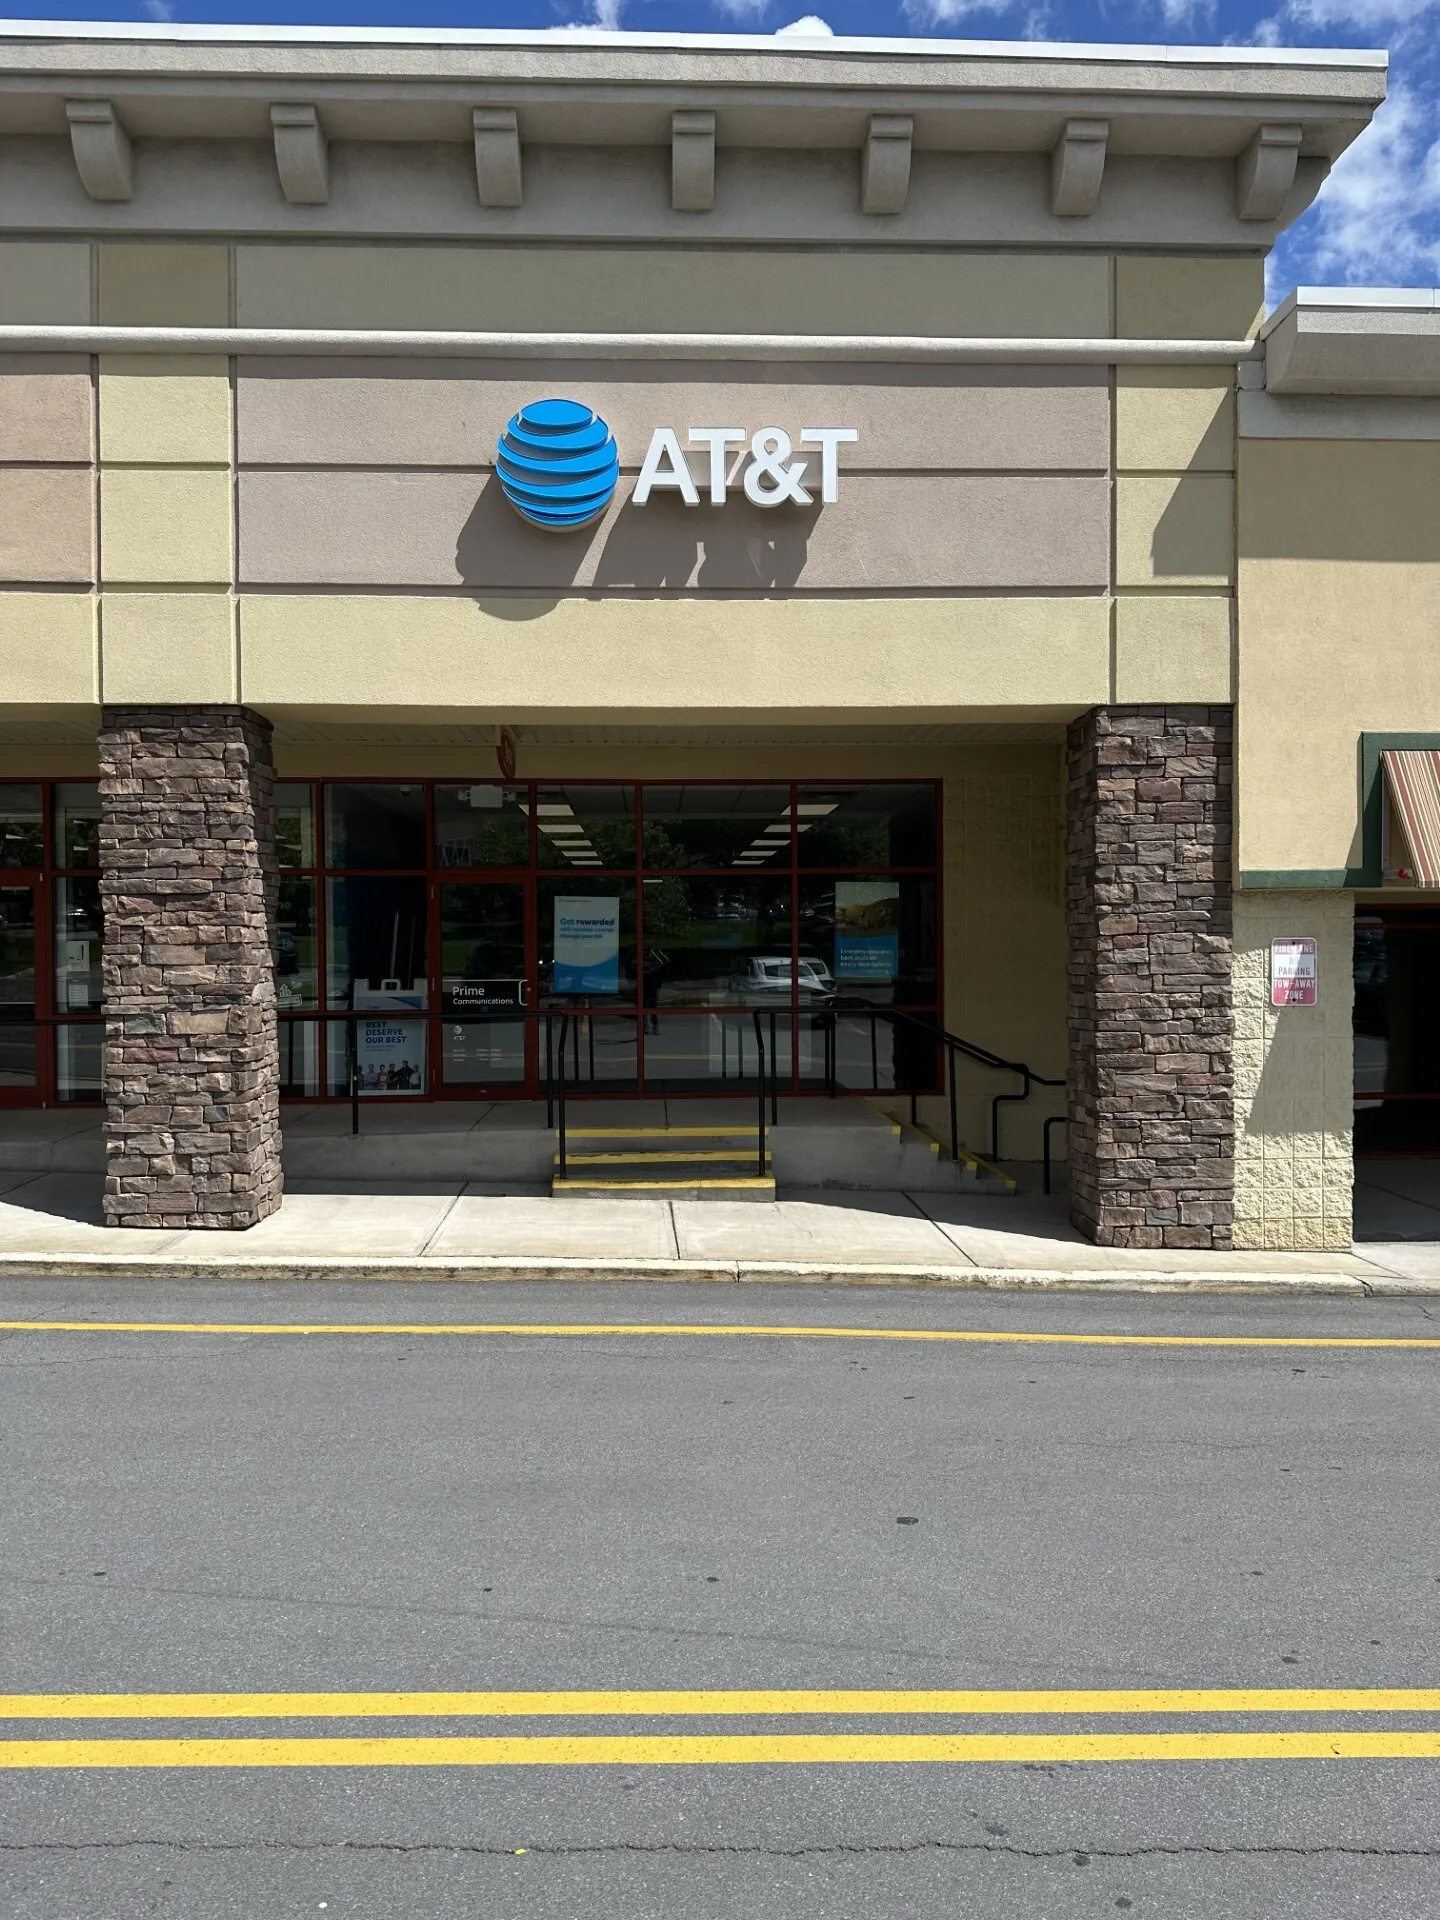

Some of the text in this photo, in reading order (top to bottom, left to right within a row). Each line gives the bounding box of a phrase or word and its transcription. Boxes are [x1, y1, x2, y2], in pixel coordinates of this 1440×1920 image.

[632, 426, 859, 508] AT&T
[560, 918, 615, 926] Get rewarded
[1274, 978, 1316, 988] TOW-AWAY
[452, 986, 485, 996] Prime
[1284, 990, 1304, 1000] ZONE
[452, 997, 514, 1005] Communications
[365, 1028, 404, 1036] DESERVE
[365, 1036, 385, 1044] OUR
